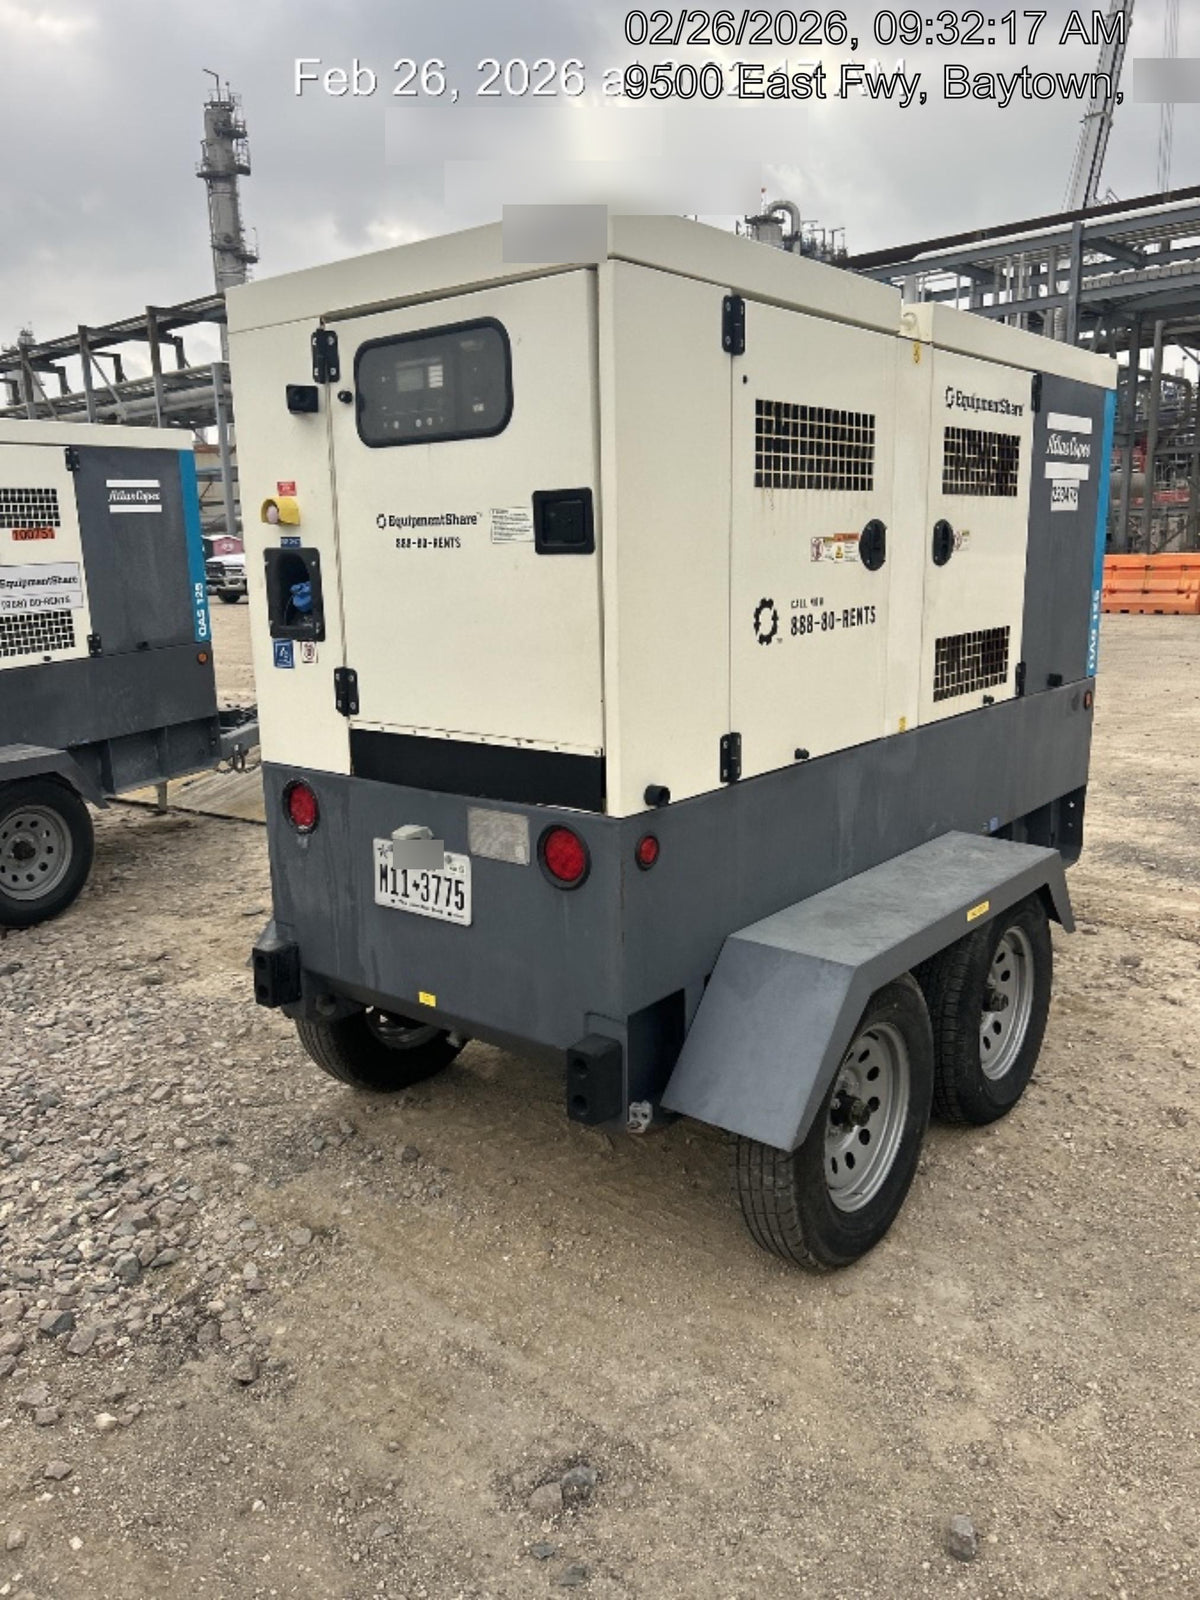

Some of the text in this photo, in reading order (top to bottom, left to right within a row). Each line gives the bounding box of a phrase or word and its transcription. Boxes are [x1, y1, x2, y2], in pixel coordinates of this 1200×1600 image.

[388, 512, 477, 529] EquipmentShare
[395, 536, 461, 549] 888-80-RENTS
[790, 605, 876, 636] 888-80-RENTS
